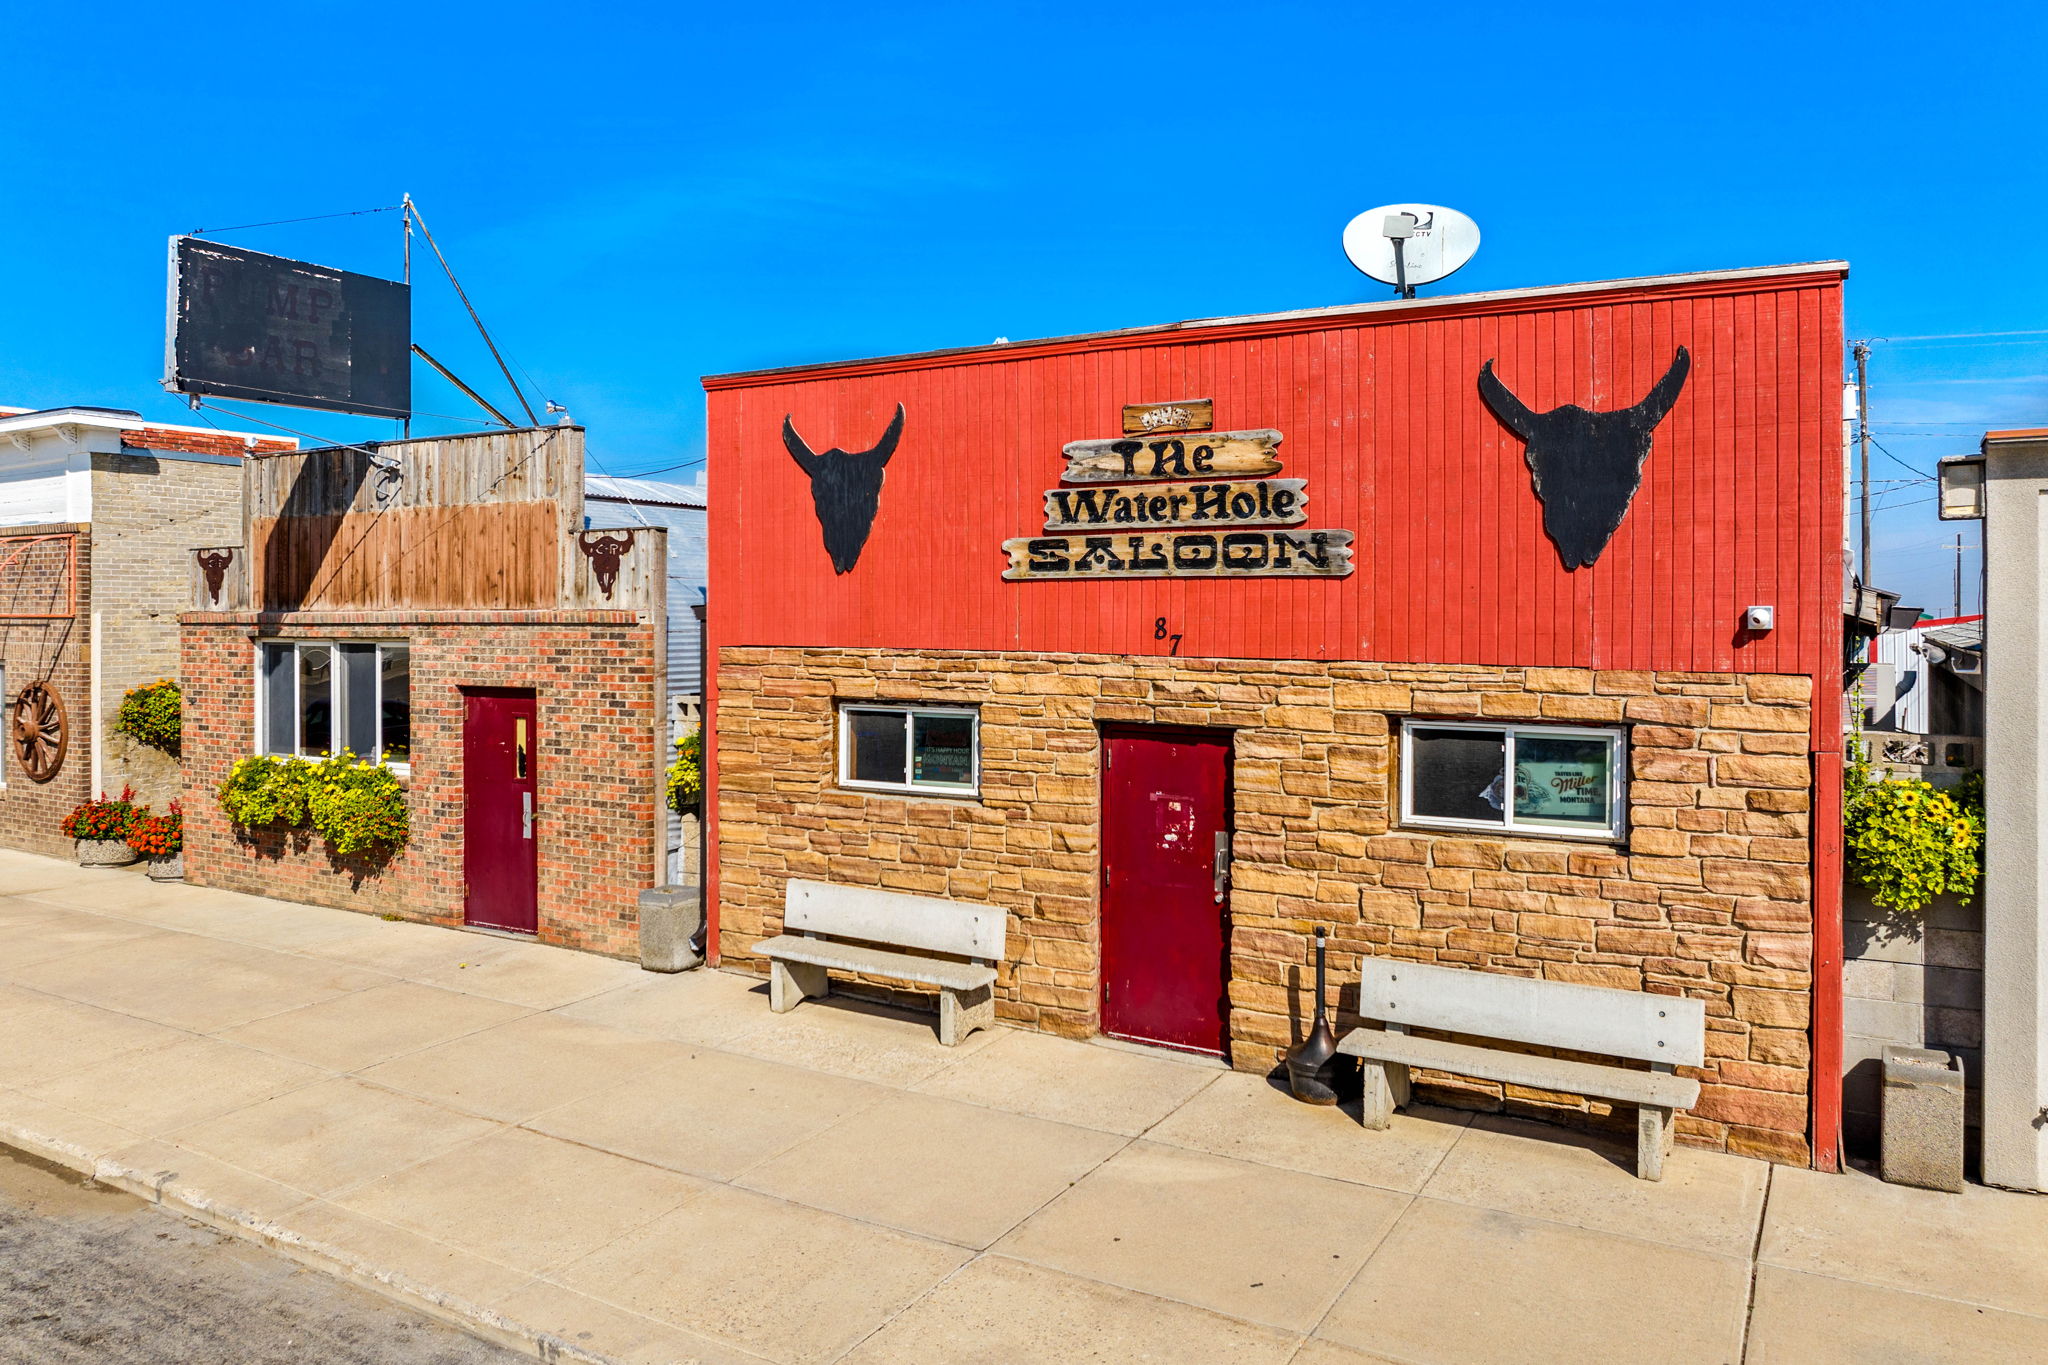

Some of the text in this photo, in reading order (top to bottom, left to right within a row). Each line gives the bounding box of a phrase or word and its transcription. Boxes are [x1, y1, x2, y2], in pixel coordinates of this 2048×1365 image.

[1028, 532, 1329, 572] SALOON
[1551, 776, 1600, 794] Miller
[1560, 796, 1595, 804] MONTANA
